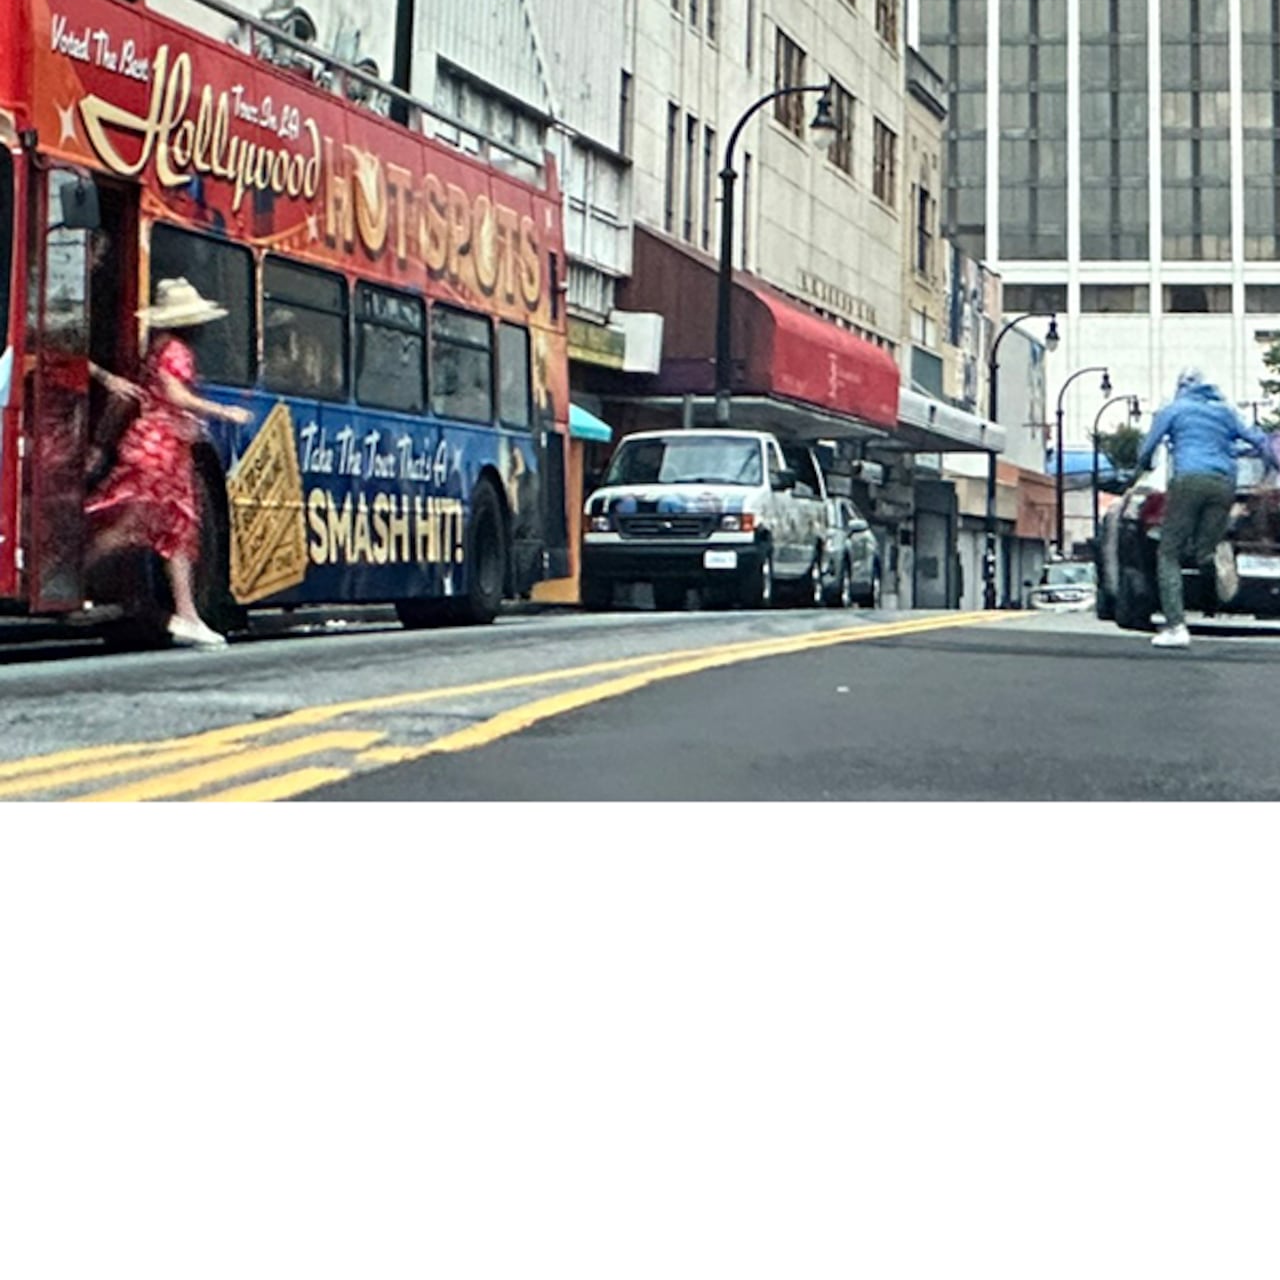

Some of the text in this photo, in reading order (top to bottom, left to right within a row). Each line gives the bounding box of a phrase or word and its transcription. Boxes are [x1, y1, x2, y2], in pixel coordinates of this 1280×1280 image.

[51, 13, 90, 60] Voted
[92, 27, 117, 71] The
[78, 44, 321, 212] Hollywood
[301, 420, 333, 473] Take
[336, 424, 361, 475] The
[363, 428, 396, 481] Tour
[432, 438, 448, 488] A
[307, 487, 409, 565] SMASH
[414, 494, 463, 564] HIT!
